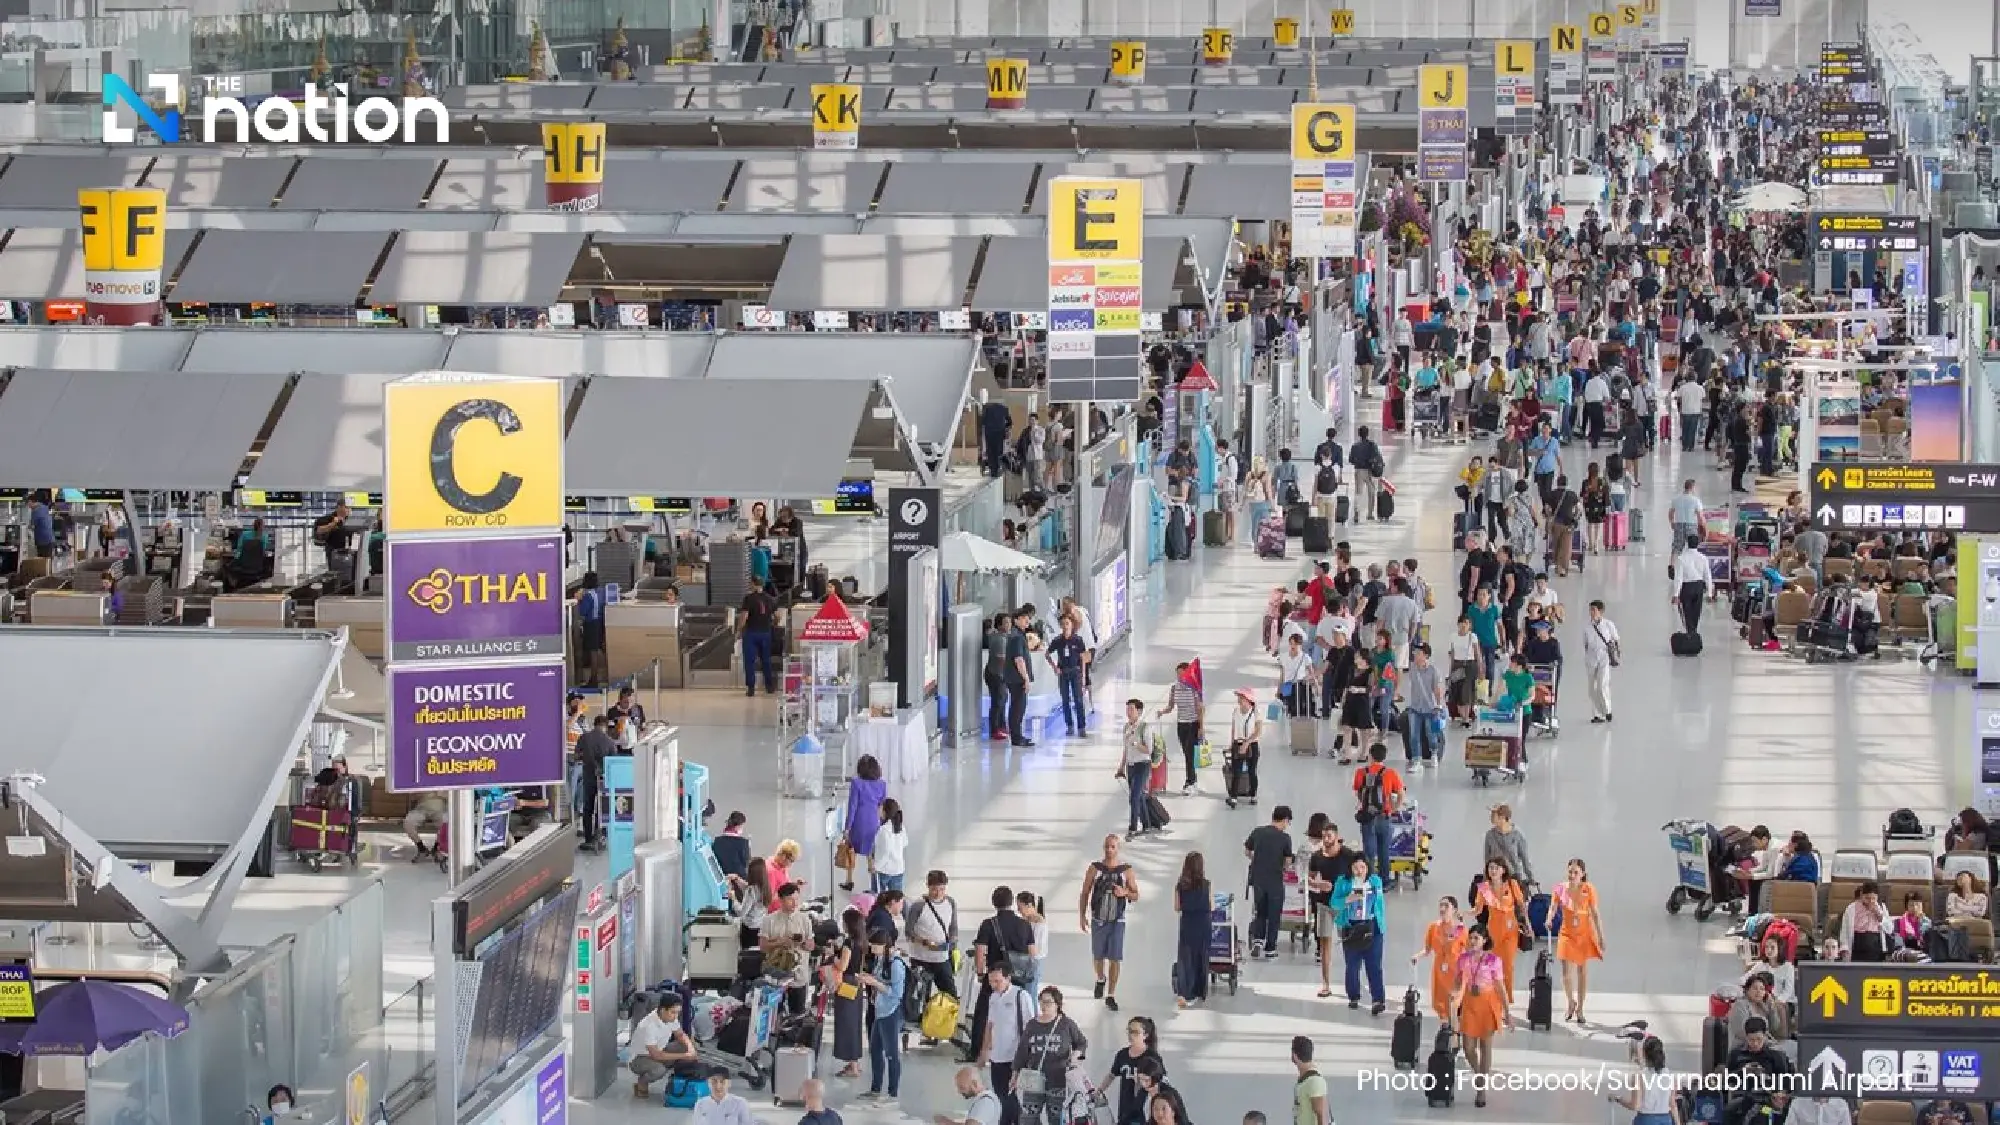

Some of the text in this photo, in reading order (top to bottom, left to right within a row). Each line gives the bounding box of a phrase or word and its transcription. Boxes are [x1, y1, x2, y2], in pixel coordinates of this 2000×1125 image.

[1594, 15, 1610, 35] Q
[1624, 7, 1635, 23] S
[1557, 28, 1574, 49] N
[1505, 45, 1523, 72] L
[1433, 70, 1454, 103] J
[1307, 111, 1342, 152] G
[1074, 188, 1118, 250] E
[126, 206, 157, 257] F
[105, 284, 141, 295] move
[430, 399, 523, 514] C
[1968, 473, 1997, 487] F-W
[445, 514, 507, 526] ROW C/D
[454, 571, 547, 604] THAI
[416, 641, 522, 657] STAR ALLIANCE
[414, 682, 515, 704] DOMESTIC
[427, 733, 526, 754] ECONOMY
[1908, 1002, 1964, 1016] Check-in
[1947, 1055, 1975, 1068] VAT
